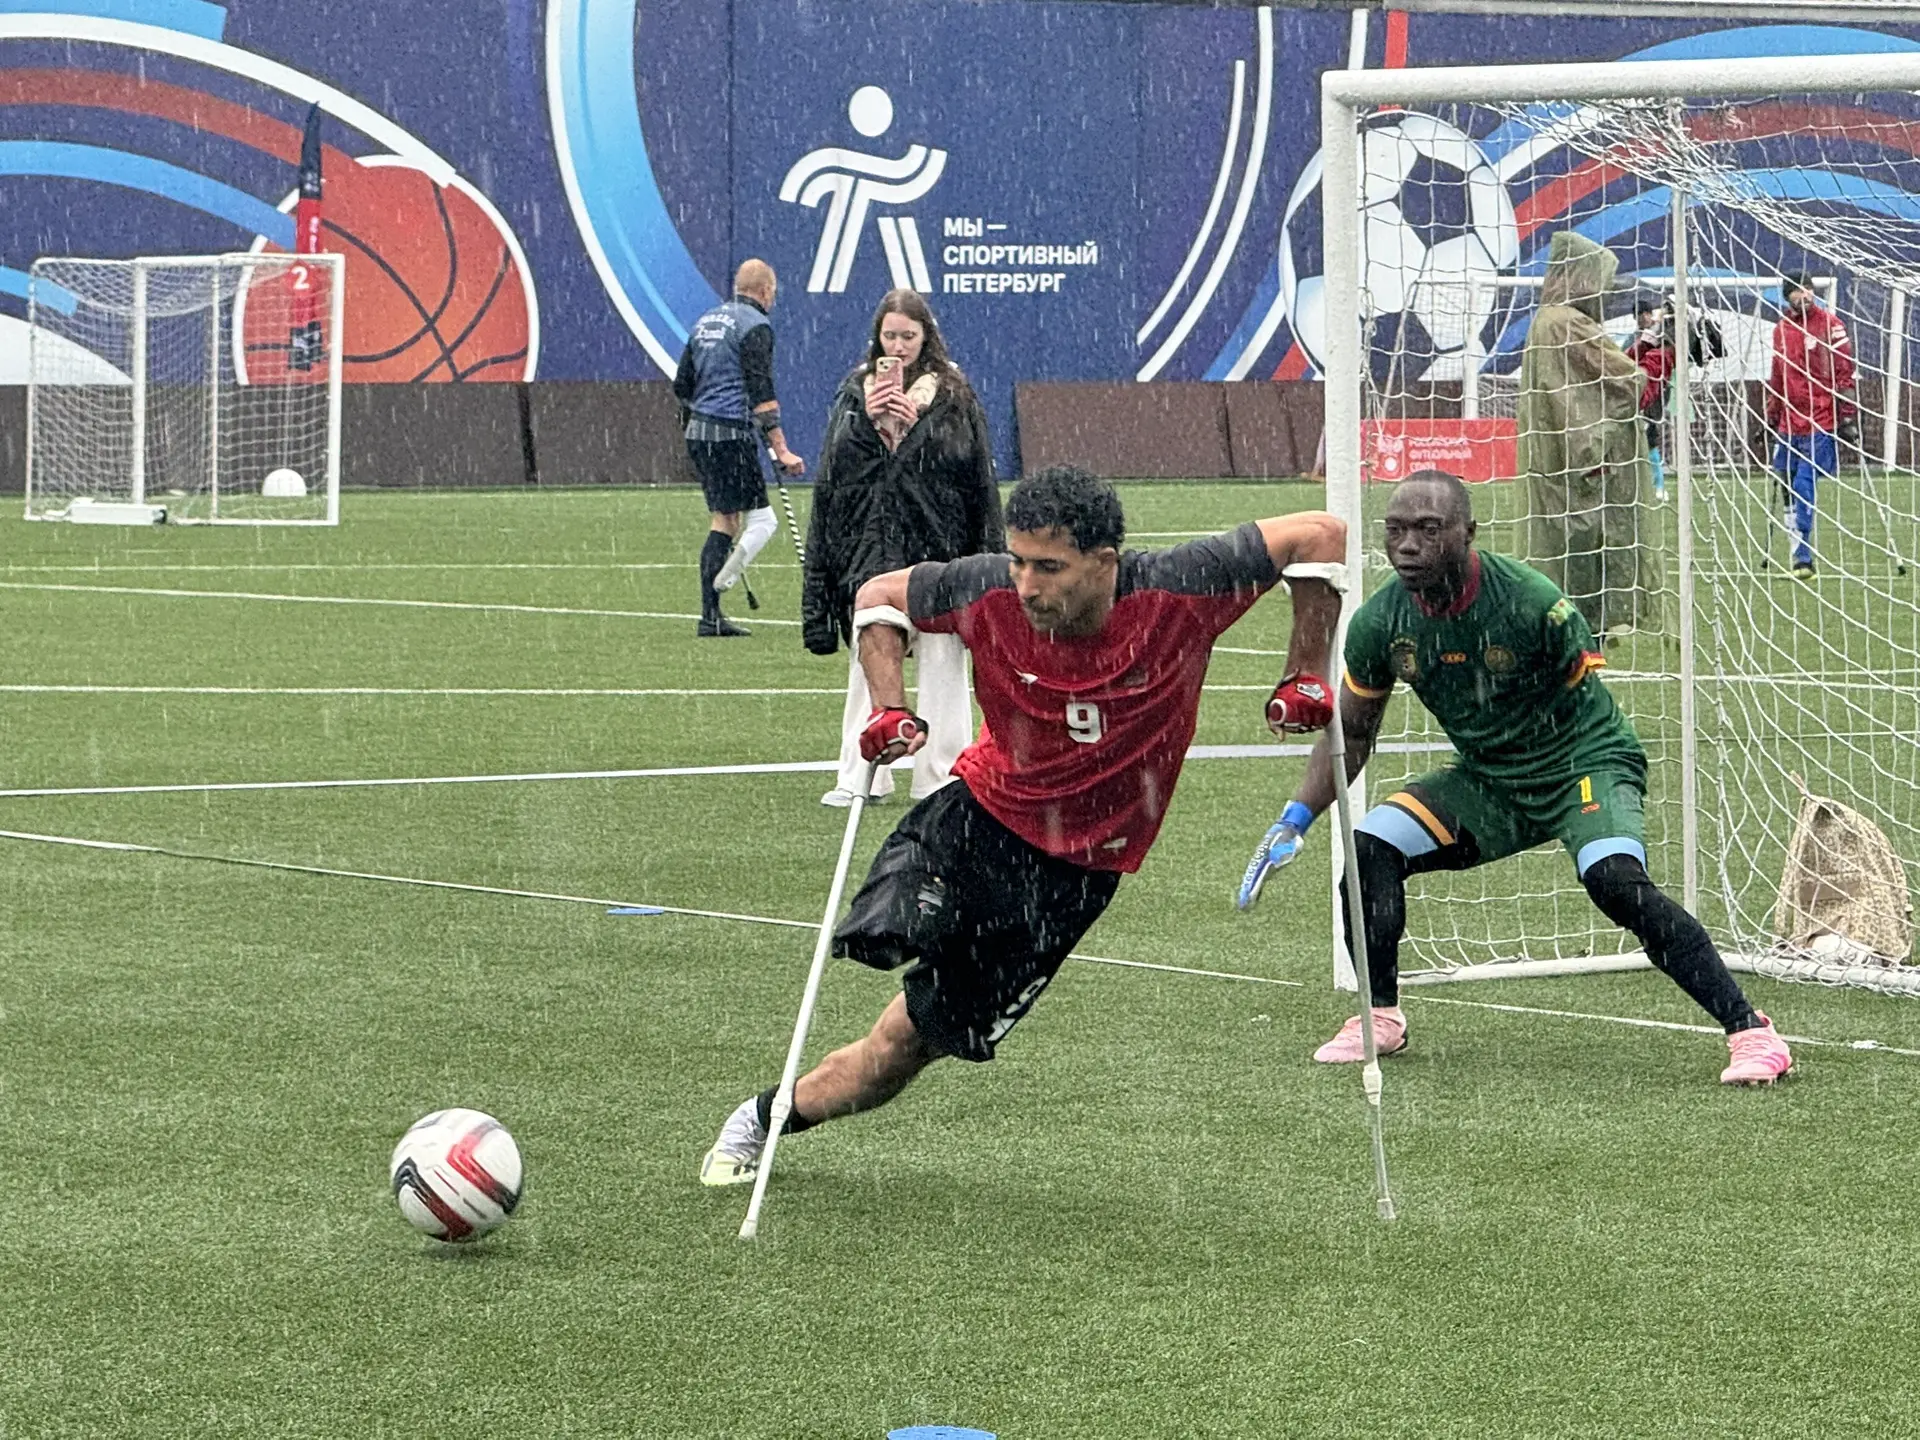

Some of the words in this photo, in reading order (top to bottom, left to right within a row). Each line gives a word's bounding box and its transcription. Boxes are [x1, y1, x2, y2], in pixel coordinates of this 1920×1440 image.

[943, 217, 983, 237] МЫ
[943, 241, 1098, 265] СПОРТИВНЫЙ
[291, 266, 310, 289] 2
[943, 273, 1066, 293] ПЕТЕРБУРГ
[1066, 702, 1102, 743] 9
[1576, 776, 1593, 803] 1
